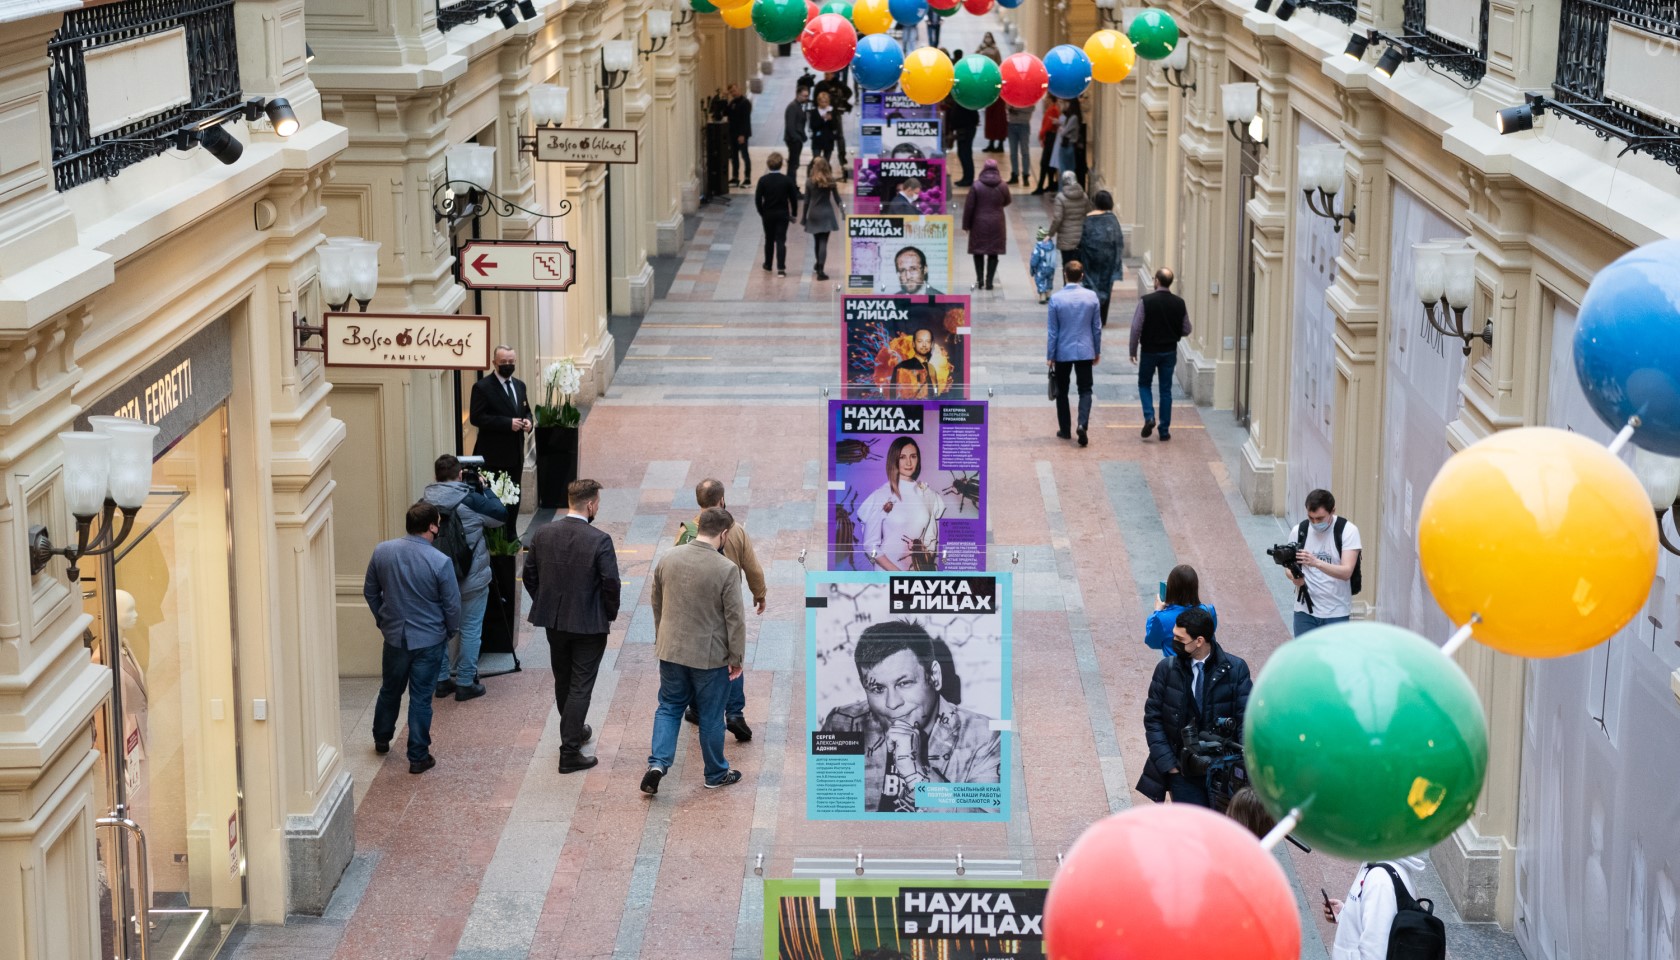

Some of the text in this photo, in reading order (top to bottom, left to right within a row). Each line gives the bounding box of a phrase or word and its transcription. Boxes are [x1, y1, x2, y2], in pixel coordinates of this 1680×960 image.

[905, 128, 938, 136] ЛИЦАХ
[546, 135, 577, 152] Bosco
[881, 161, 917, 170] НАУКА
[888, 169, 926, 178] ЛИЦАХ
[850, 219, 892, 228] НАУКА
[859, 227, 902, 237] ЛИЦАХ
[846, 300, 896, 310] НАУКА
[857, 310, 909, 321] ЛИЦАХ
[342, 325, 392, 351] Bosco
[1421, 306, 1447, 359] DIOR
[145, 357, 192, 425] FERRETTI
[844, 406, 905, 419] НАУКА
[844, 419, 921, 432] в ЛИЦАХ
[893, 580, 973, 595] НАУКА
[893, 595, 992, 612] в ЛИЦАХ
[904, 892, 1016, 913] НАУКА
[904, 914, 1043, 937] в ЛИЦАХ
